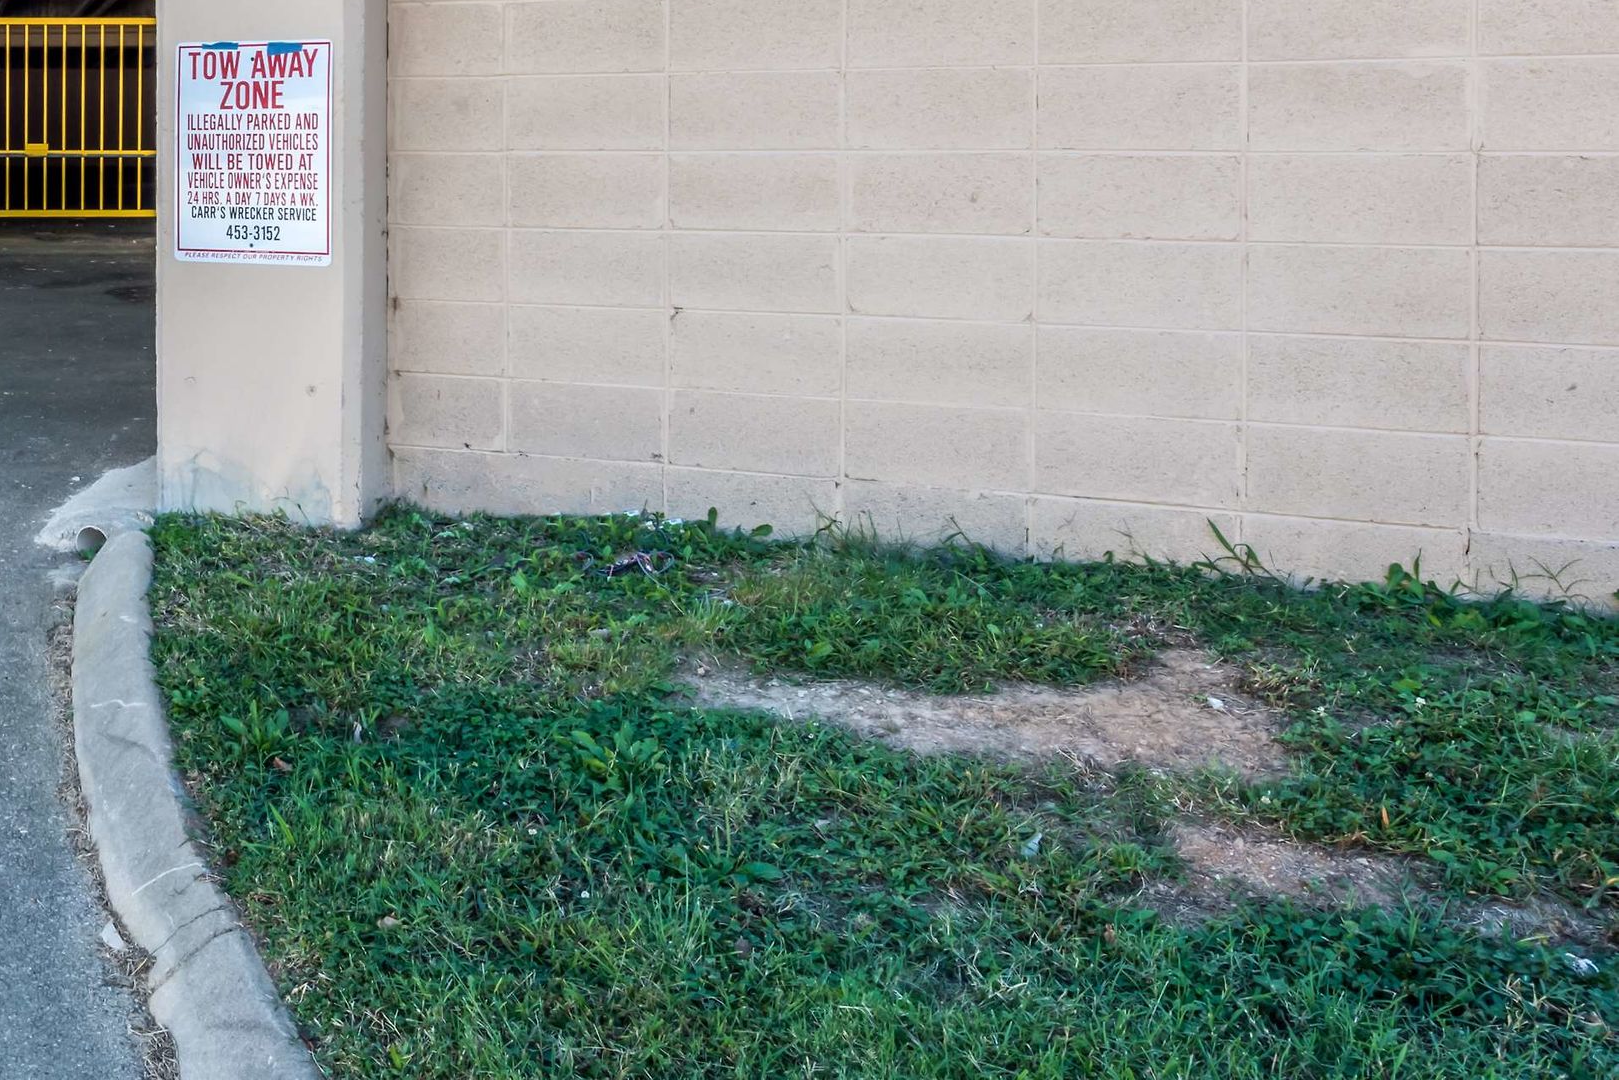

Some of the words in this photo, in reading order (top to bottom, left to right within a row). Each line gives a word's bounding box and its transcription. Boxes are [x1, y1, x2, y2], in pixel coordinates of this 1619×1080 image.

[188, 51, 241, 79] TOW
[251, 48, 318, 79] AWAY
[220, 81, 284, 109] ZONE
[188, 114, 242, 130] ILLEGALLY
[247, 113, 291, 130] PARKED
[295, 113, 318, 130] AND
[188, 134, 265, 150] UNAUTHORIZED
[270, 134, 318, 150] VEHICLES
[192, 153, 222, 170] WILL
[227, 153, 242, 170] BE
[248, 153, 292, 170] TOWED
[299, 153, 314, 170] AT
[188, 172, 224, 189] VEHICLE
[228, 172, 271, 189] OWNER'S
[275, 173, 318, 190] EXPENSE
[188, 191, 199, 204] 24
[202, 192, 222, 205] HRS.
[226, 192, 232, 205] A
[235, 192, 252, 205] DAY
[256, 192, 261, 205] 7
[264, 192, 286, 206] DAYS
[290, 193, 296, 206] A
[300, 193, 318, 206] WK.
[191, 206, 226, 219] CARR'S
[229, 207, 275, 220] WRECKER
[278, 207, 317, 221] SERVICE
[226, 225, 280, 241] 453-3152
